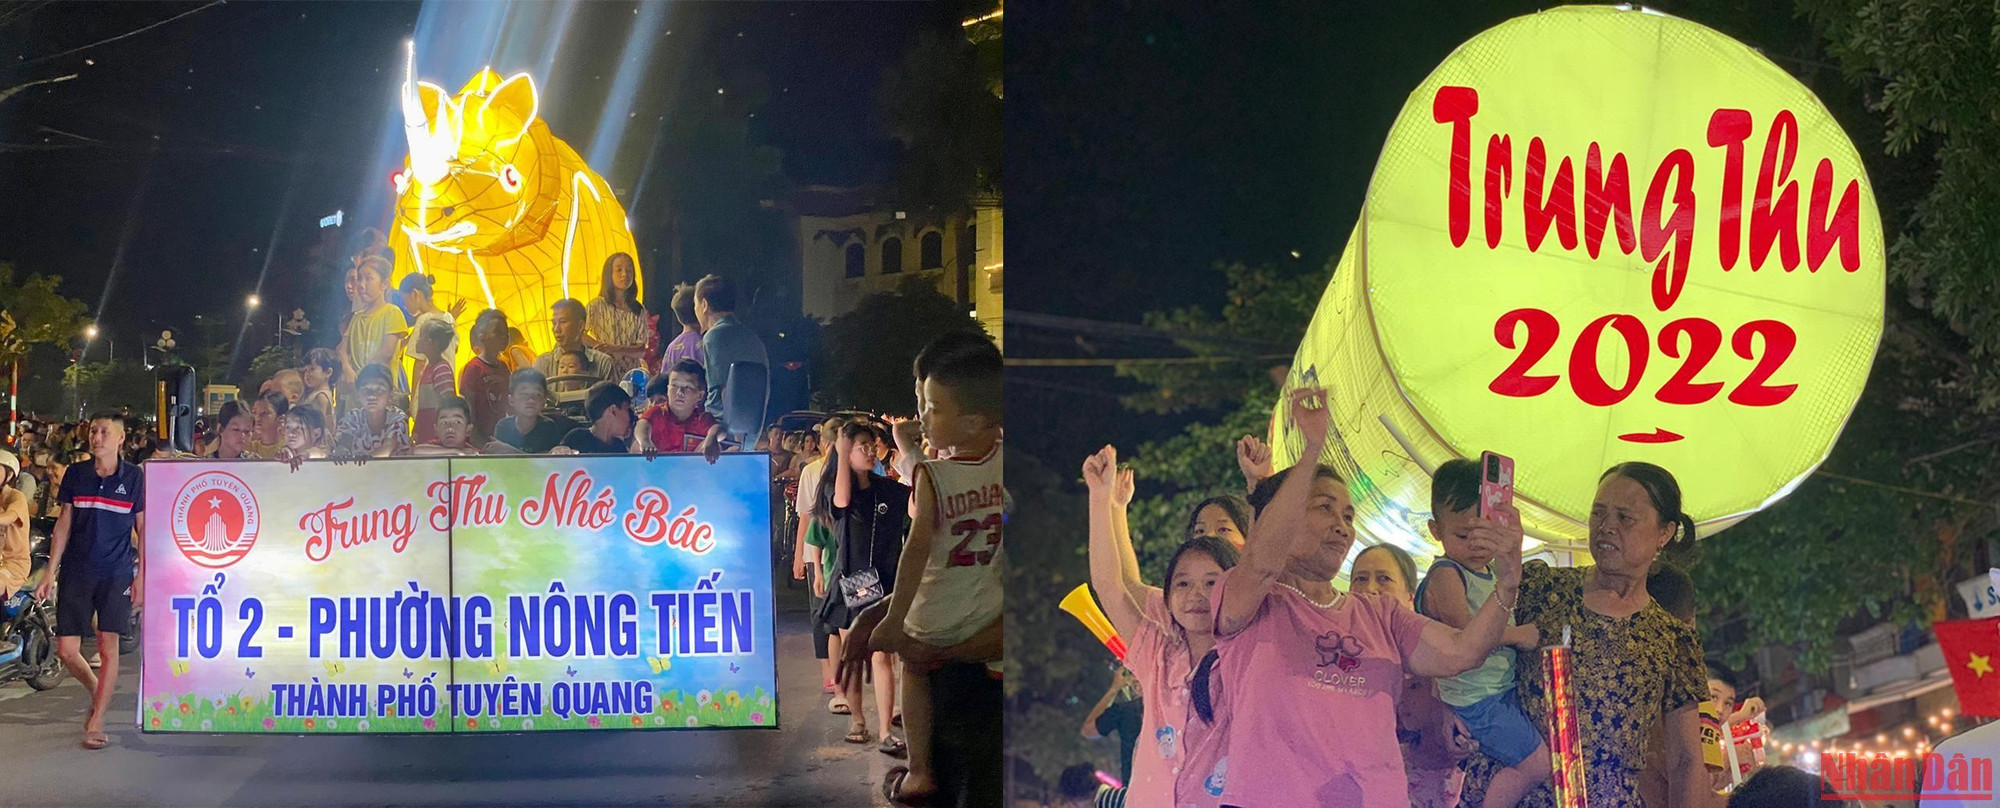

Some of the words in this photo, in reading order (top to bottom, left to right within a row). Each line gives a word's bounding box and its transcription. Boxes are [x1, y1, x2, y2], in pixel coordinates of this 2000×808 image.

[1433, 86, 1695, 311] Trung
[1707, 108, 1860, 273] Thu
[1488, 308, 1798, 406] 2022
[240, 492, 254, 525] QUANG
[300, 496, 418, 561] Trung
[427, 474, 508, 531] Thu
[520, 470, 615, 529] Nhớ
[625, 490, 714, 552] Bác
[946, 513, 1002, 568] 23
[172, 572, 225, 659] TỔ
[237, 597, 264, 658] 2
[309, 581, 492, 659] PHƯỜNG
[509, 581, 637, 657] NÔNG
[652, 572, 752, 655] TIẾN
[271, 676, 367, 717] THÀNH
[378, 672, 437, 717] PHỐ
[446, 676, 541, 717] TUYÊN
[553, 681, 653, 719] QUANG
[1314, 670, 1366, 687] CLOVER
